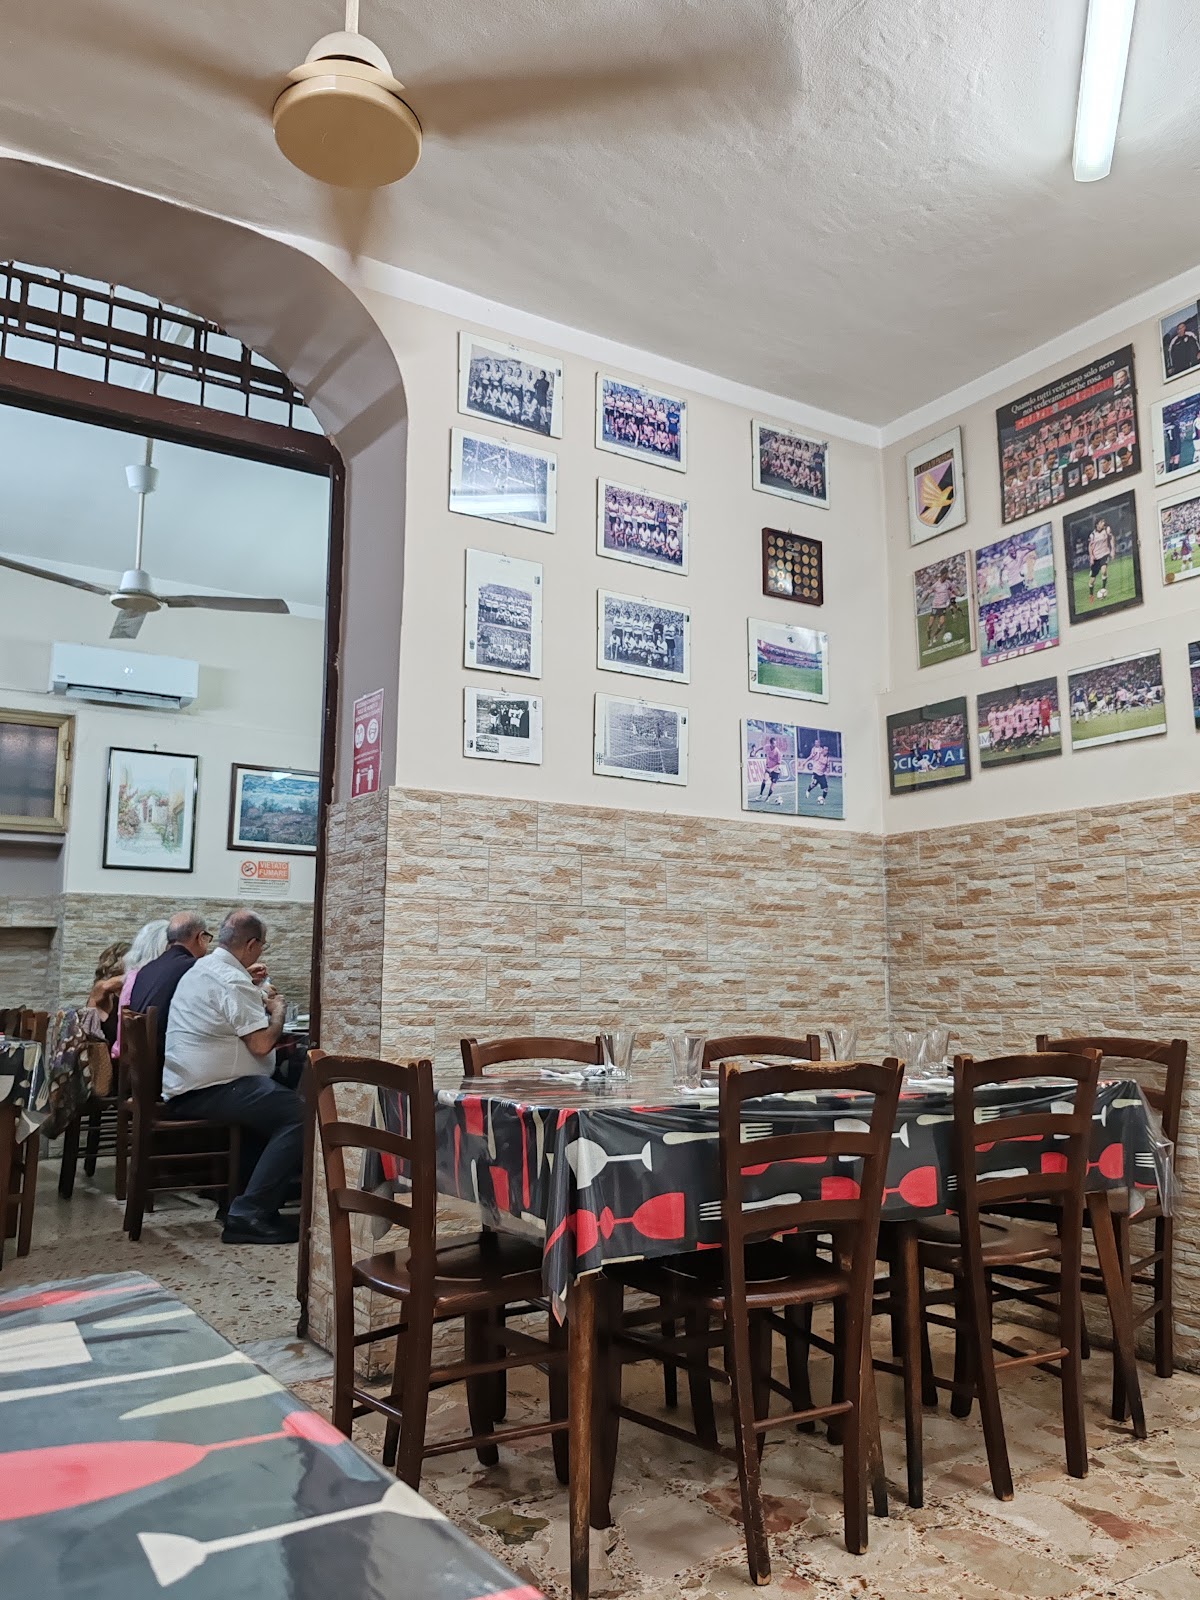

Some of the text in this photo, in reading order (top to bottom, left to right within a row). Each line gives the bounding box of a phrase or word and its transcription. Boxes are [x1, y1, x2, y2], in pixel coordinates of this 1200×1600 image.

[1011, 397, 1036, 414] Quando
[1036, 388, 1052, 402] tutti
[1052, 375, 1083, 394] vedevano
[1083, 367, 1098, 379] solo
[1099, 359, 1115, 372] nero
[1022, 407, 1034, 416] noi
[1034, 392, 1066, 412] vedevamo
[1066, 382, 1086, 398] anche
[259, 869, 287, 877] FUMARE
